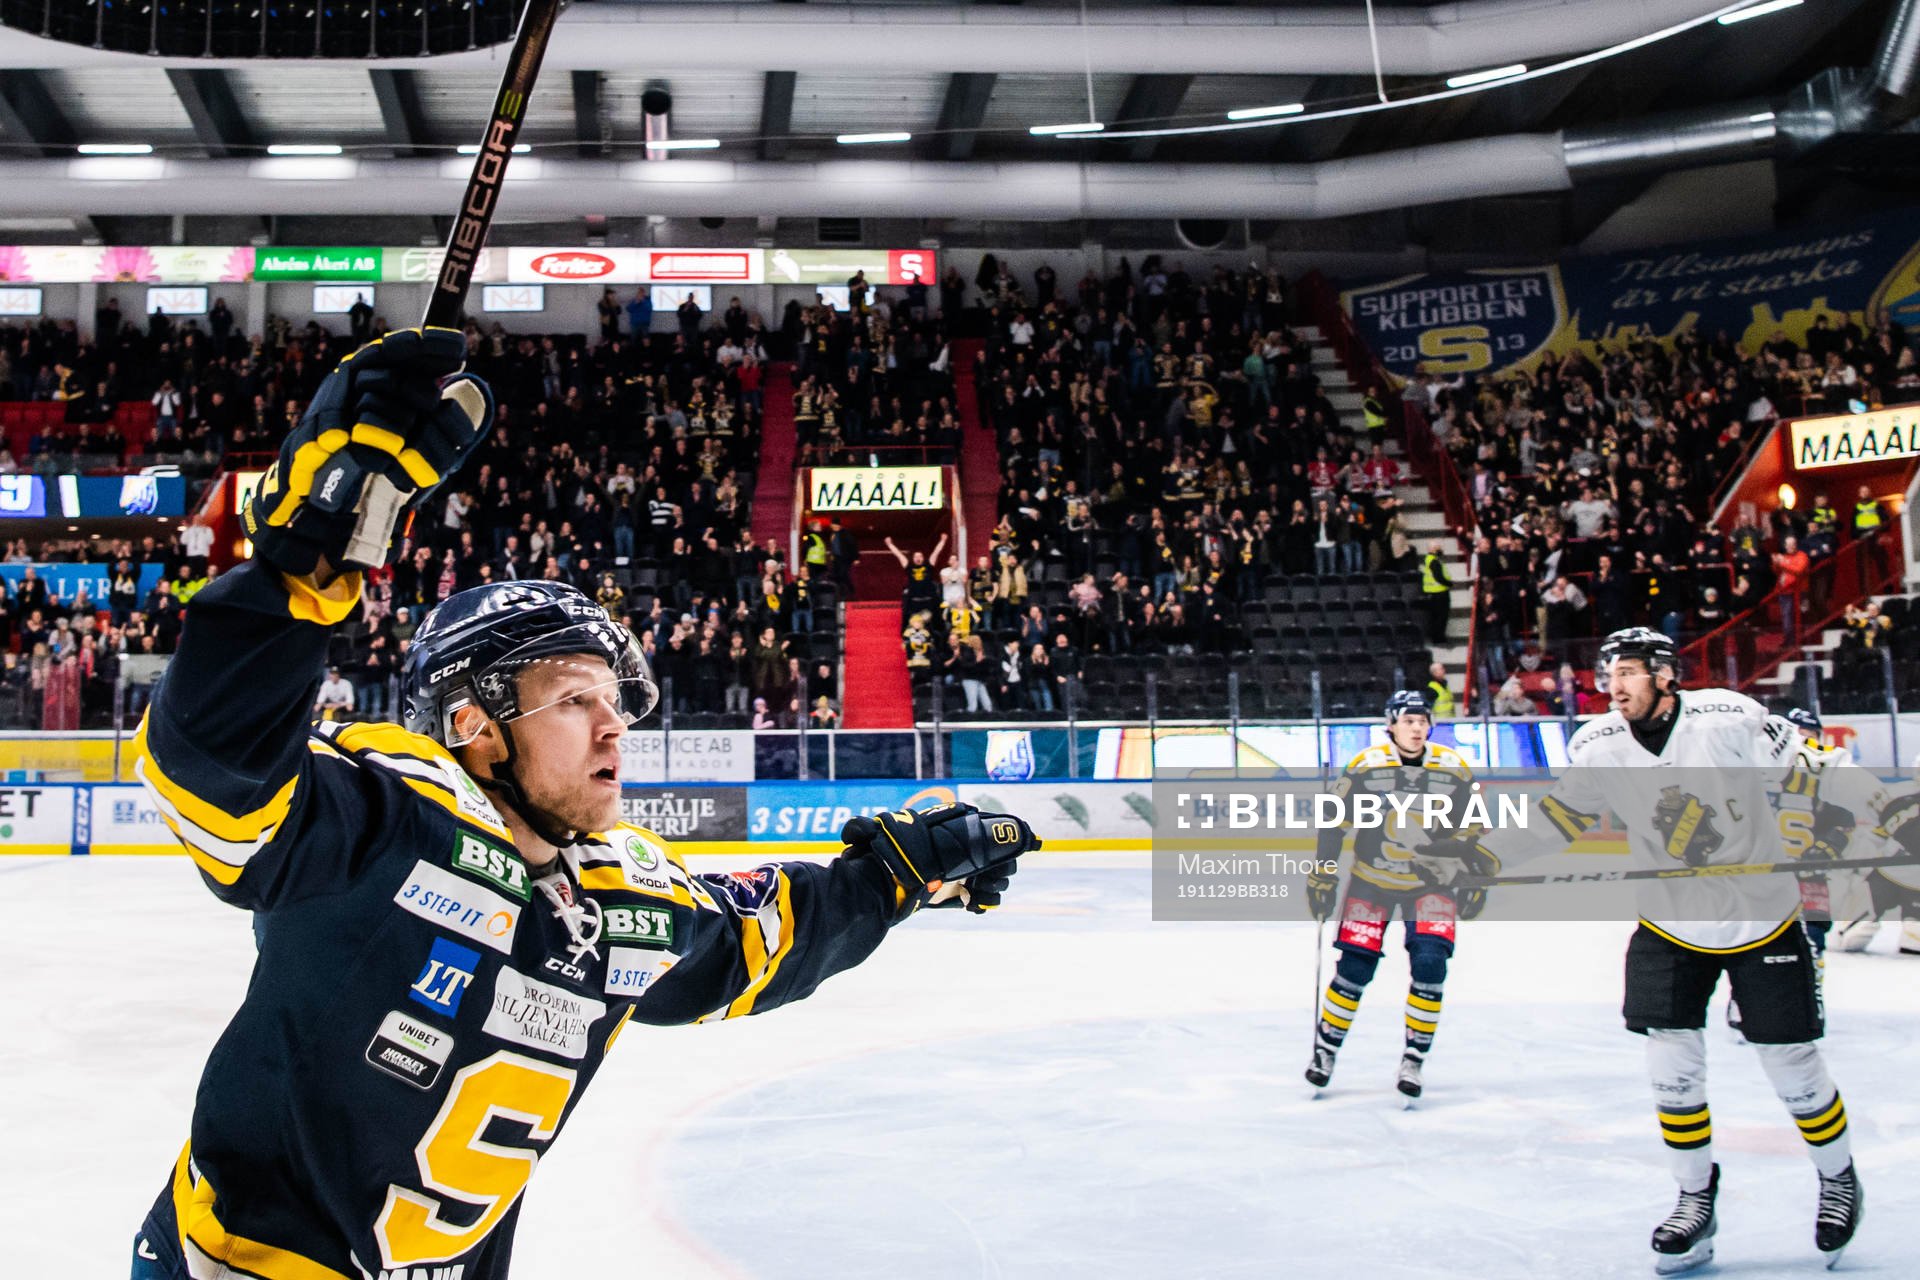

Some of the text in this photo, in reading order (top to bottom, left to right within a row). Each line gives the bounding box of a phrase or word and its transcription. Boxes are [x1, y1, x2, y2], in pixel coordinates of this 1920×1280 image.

[441, 119, 513, 293] RIBCOR
[353, 257, 376, 271] AB
[1610, 228, 1874, 282] Tillsammans
[1718, 258, 1863, 298] starka
[1360, 278, 1542, 316] SUPPORTER
[1379, 298, 1526, 331] KLUBBEN
[1383, 325, 1526, 374] 20 S 13
[817, 472, 937, 507] MÅÅÅL!
[429, 656, 471, 684] CCM
[708, 737, 733, 753] AB
[751, 807, 770, 834] 3
[775, 806, 852, 834] STEP
[459, 835, 527, 889] BST
[403, 884, 484, 927] 3 STEP IT
[603, 908, 670, 937] BST
[411, 959, 474, 1006] LT
[545, 957, 586, 981] CCM
[610, 968, 621, 985] 3
[398, 1021, 440, 1047] UNIBET
[373, 1049, 578, 1270] S
